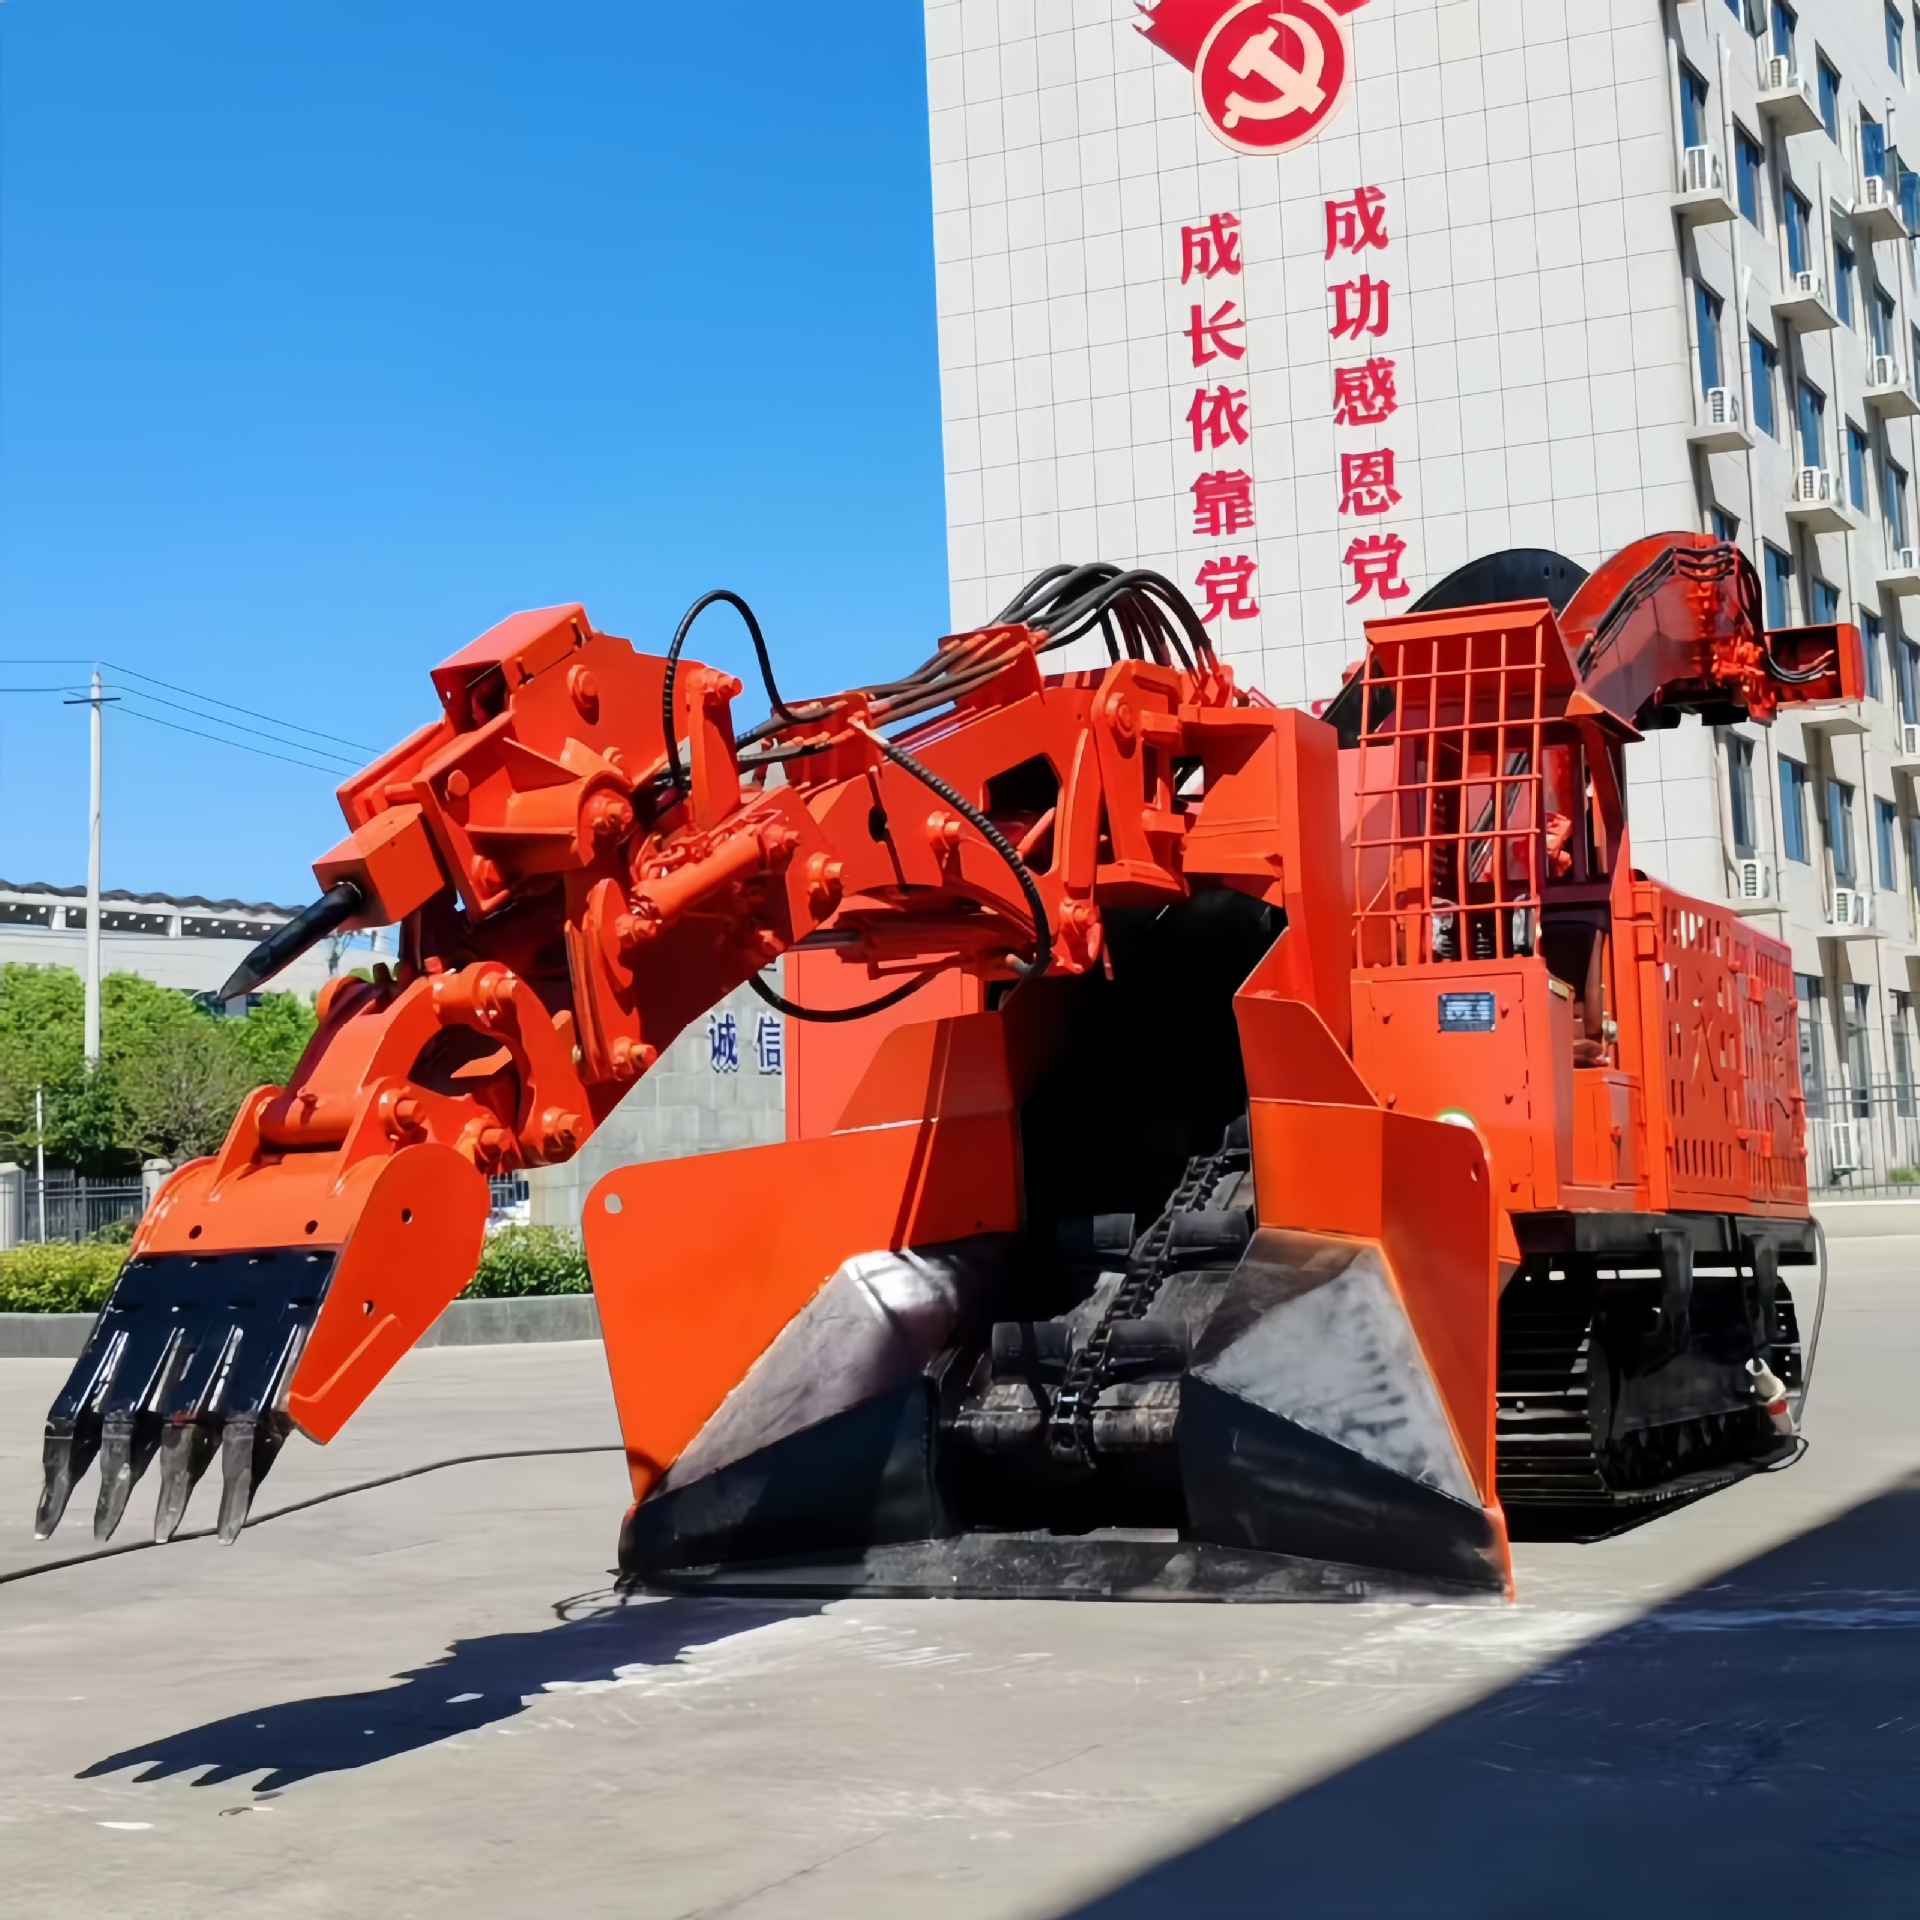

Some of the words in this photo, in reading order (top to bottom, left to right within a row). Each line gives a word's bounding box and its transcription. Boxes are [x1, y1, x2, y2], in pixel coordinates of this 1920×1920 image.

[1180, 212, 1260, 623] 成长依靠党
[1324, 185, 1411, 604] 成功感恩党
[709, 1012, 783, 1075] 诚信
